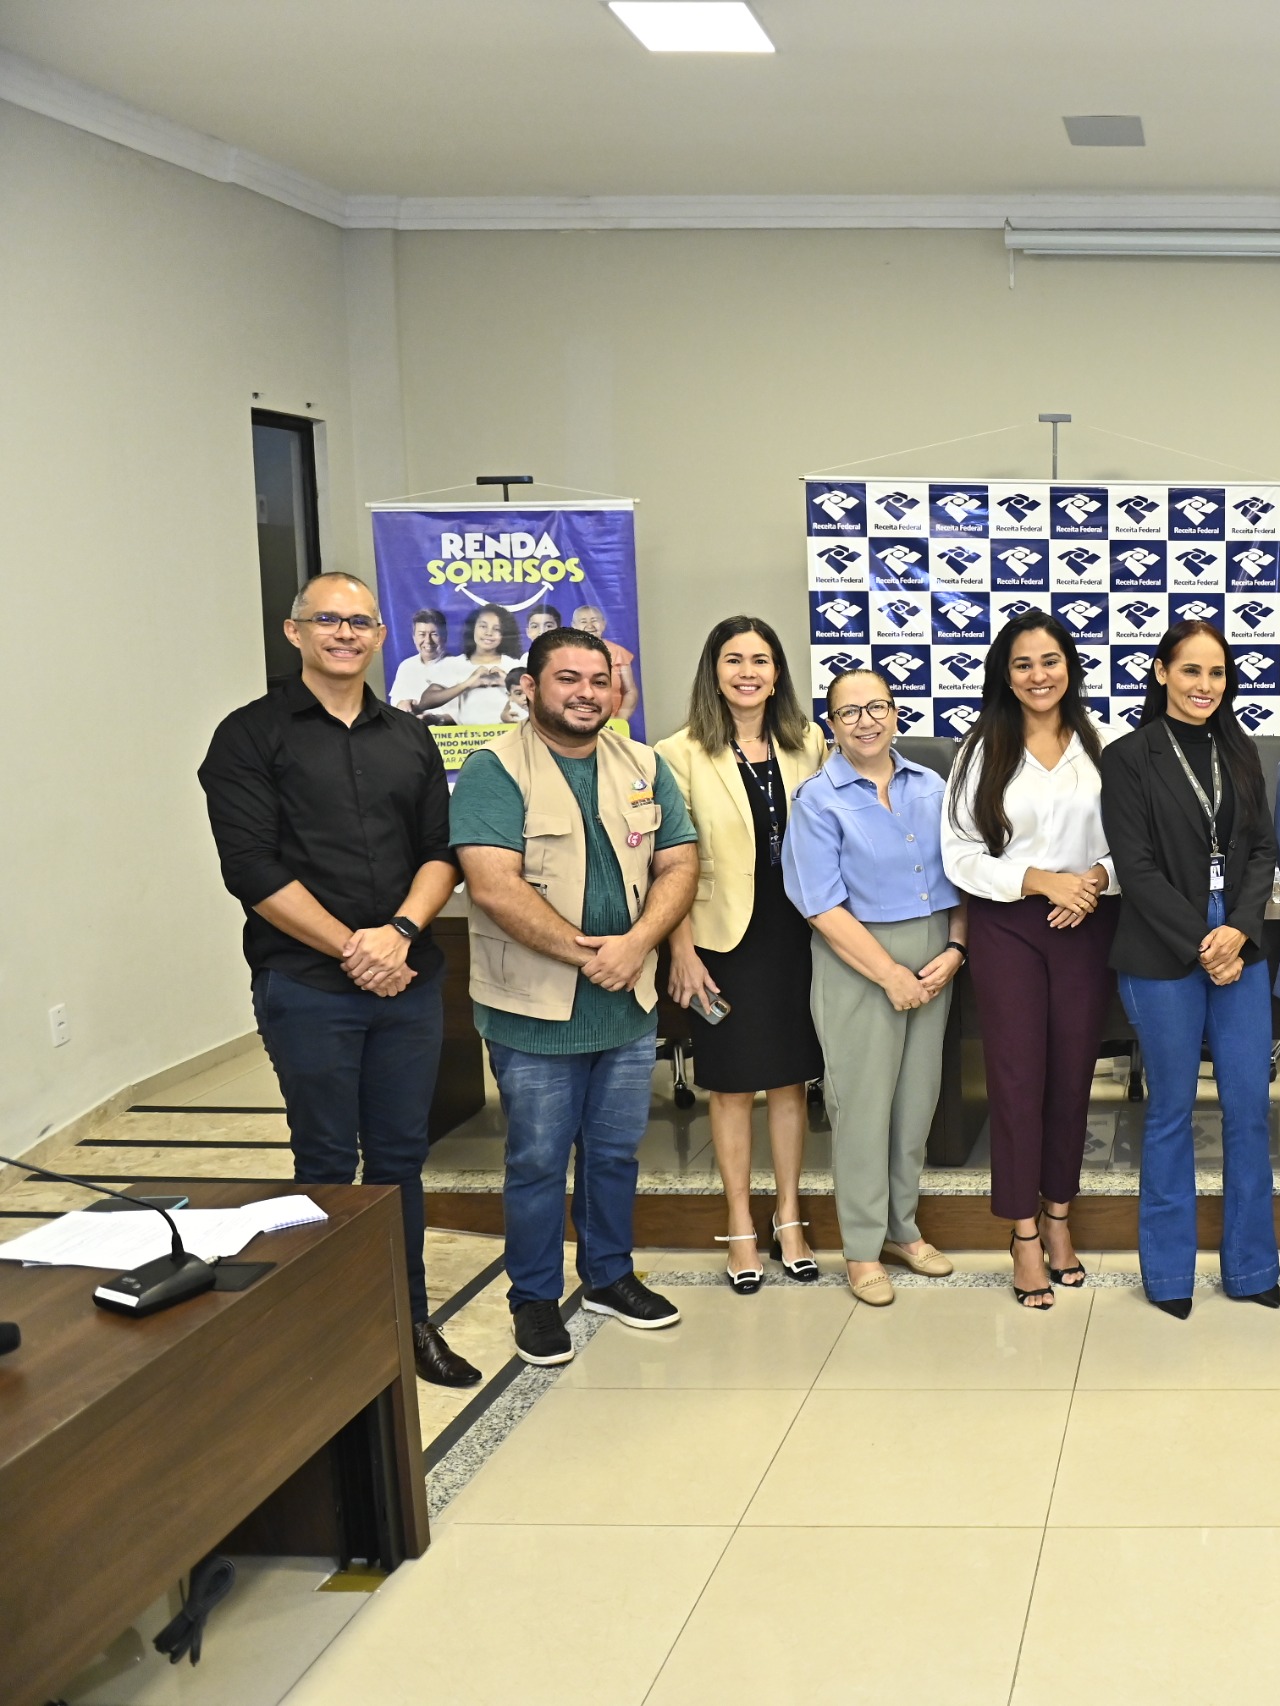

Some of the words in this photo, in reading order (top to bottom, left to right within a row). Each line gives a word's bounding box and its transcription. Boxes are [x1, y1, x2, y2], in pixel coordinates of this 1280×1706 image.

[936, 524, 959, 532] Receita
[960, 524, 982, 532] Federal
[1115, 526, 1137, 534] Receita
[1139, 526, 1161, 534] Federal
[441, 532, 560, 560] RENDA
[427, 558, 584, 585] SORRISOS
[961, 577, 983, 585] Federal
[902, 683, 926, 691] Federal
[1116, 682, 1137, 690] Receita
[454, 730, 468, 738] ATÉ
